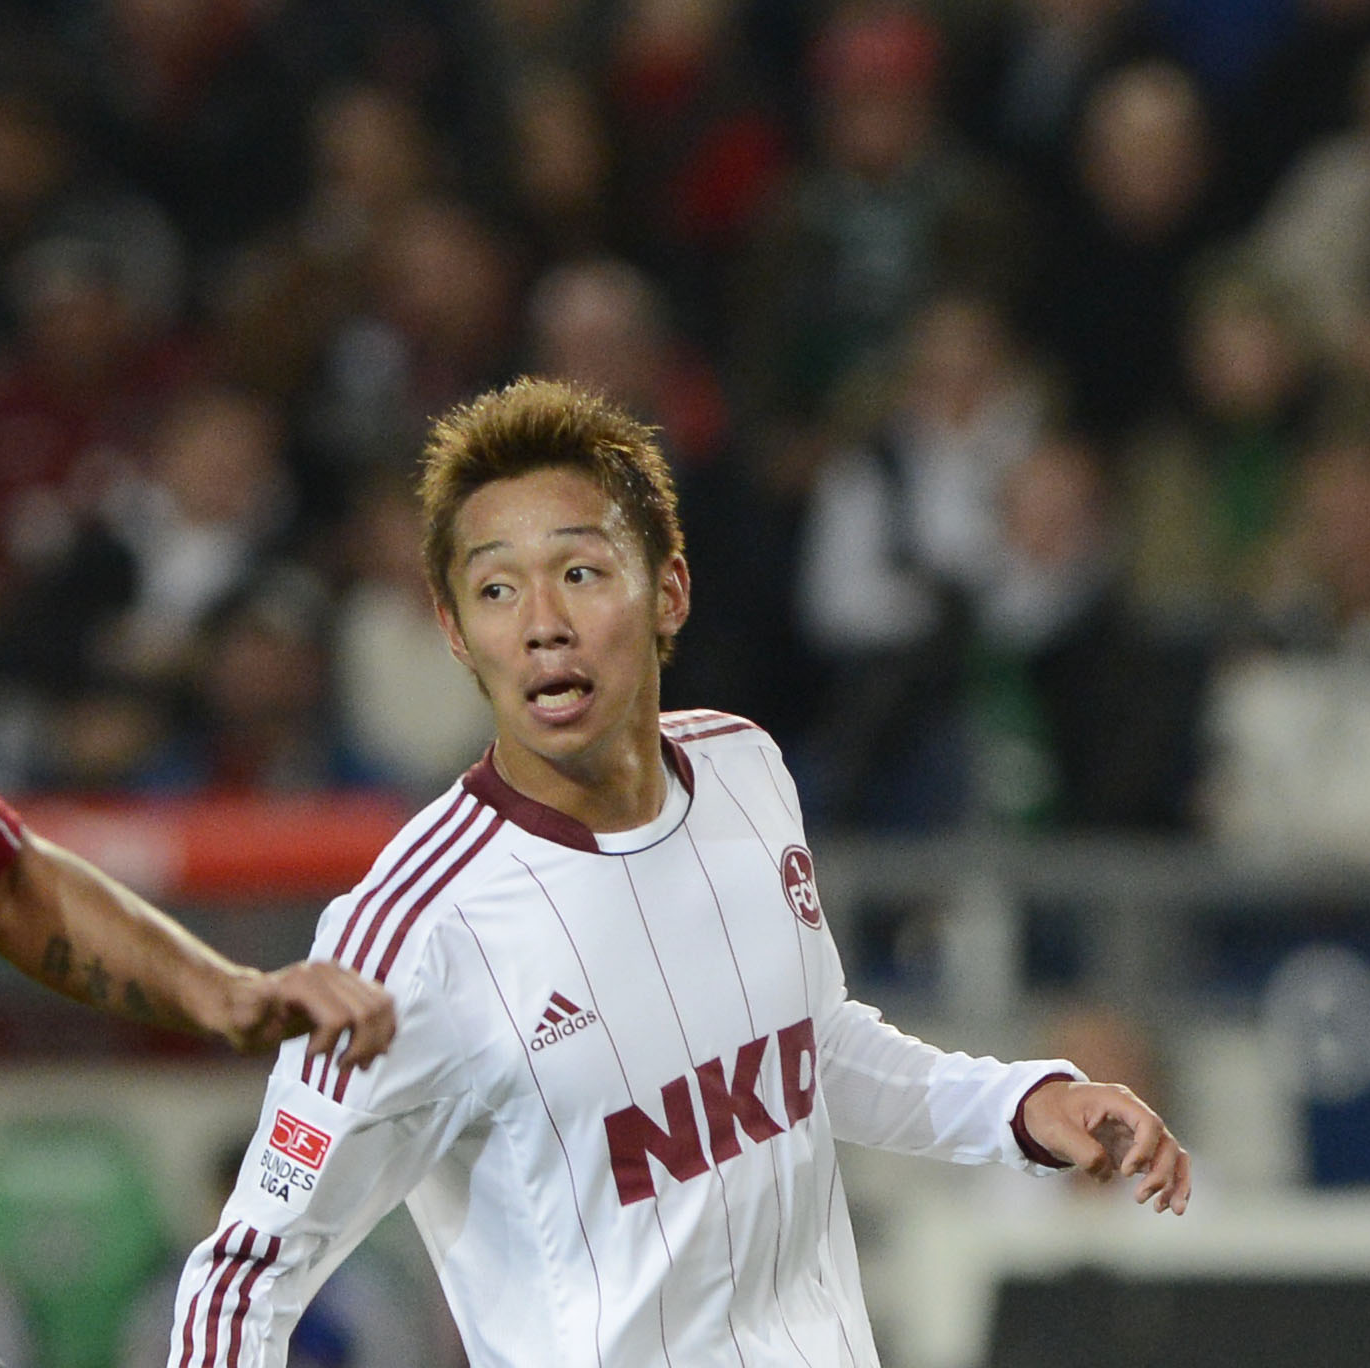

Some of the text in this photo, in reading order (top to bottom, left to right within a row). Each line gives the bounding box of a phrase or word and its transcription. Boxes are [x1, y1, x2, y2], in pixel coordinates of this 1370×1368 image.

[530, 1010, 597, 1051] adidas
[604, 1017, 817, 1207] NKD
[260, 1149, 316, 1191] BUNDES
[260, 1172, 290, 1202] LIGA
